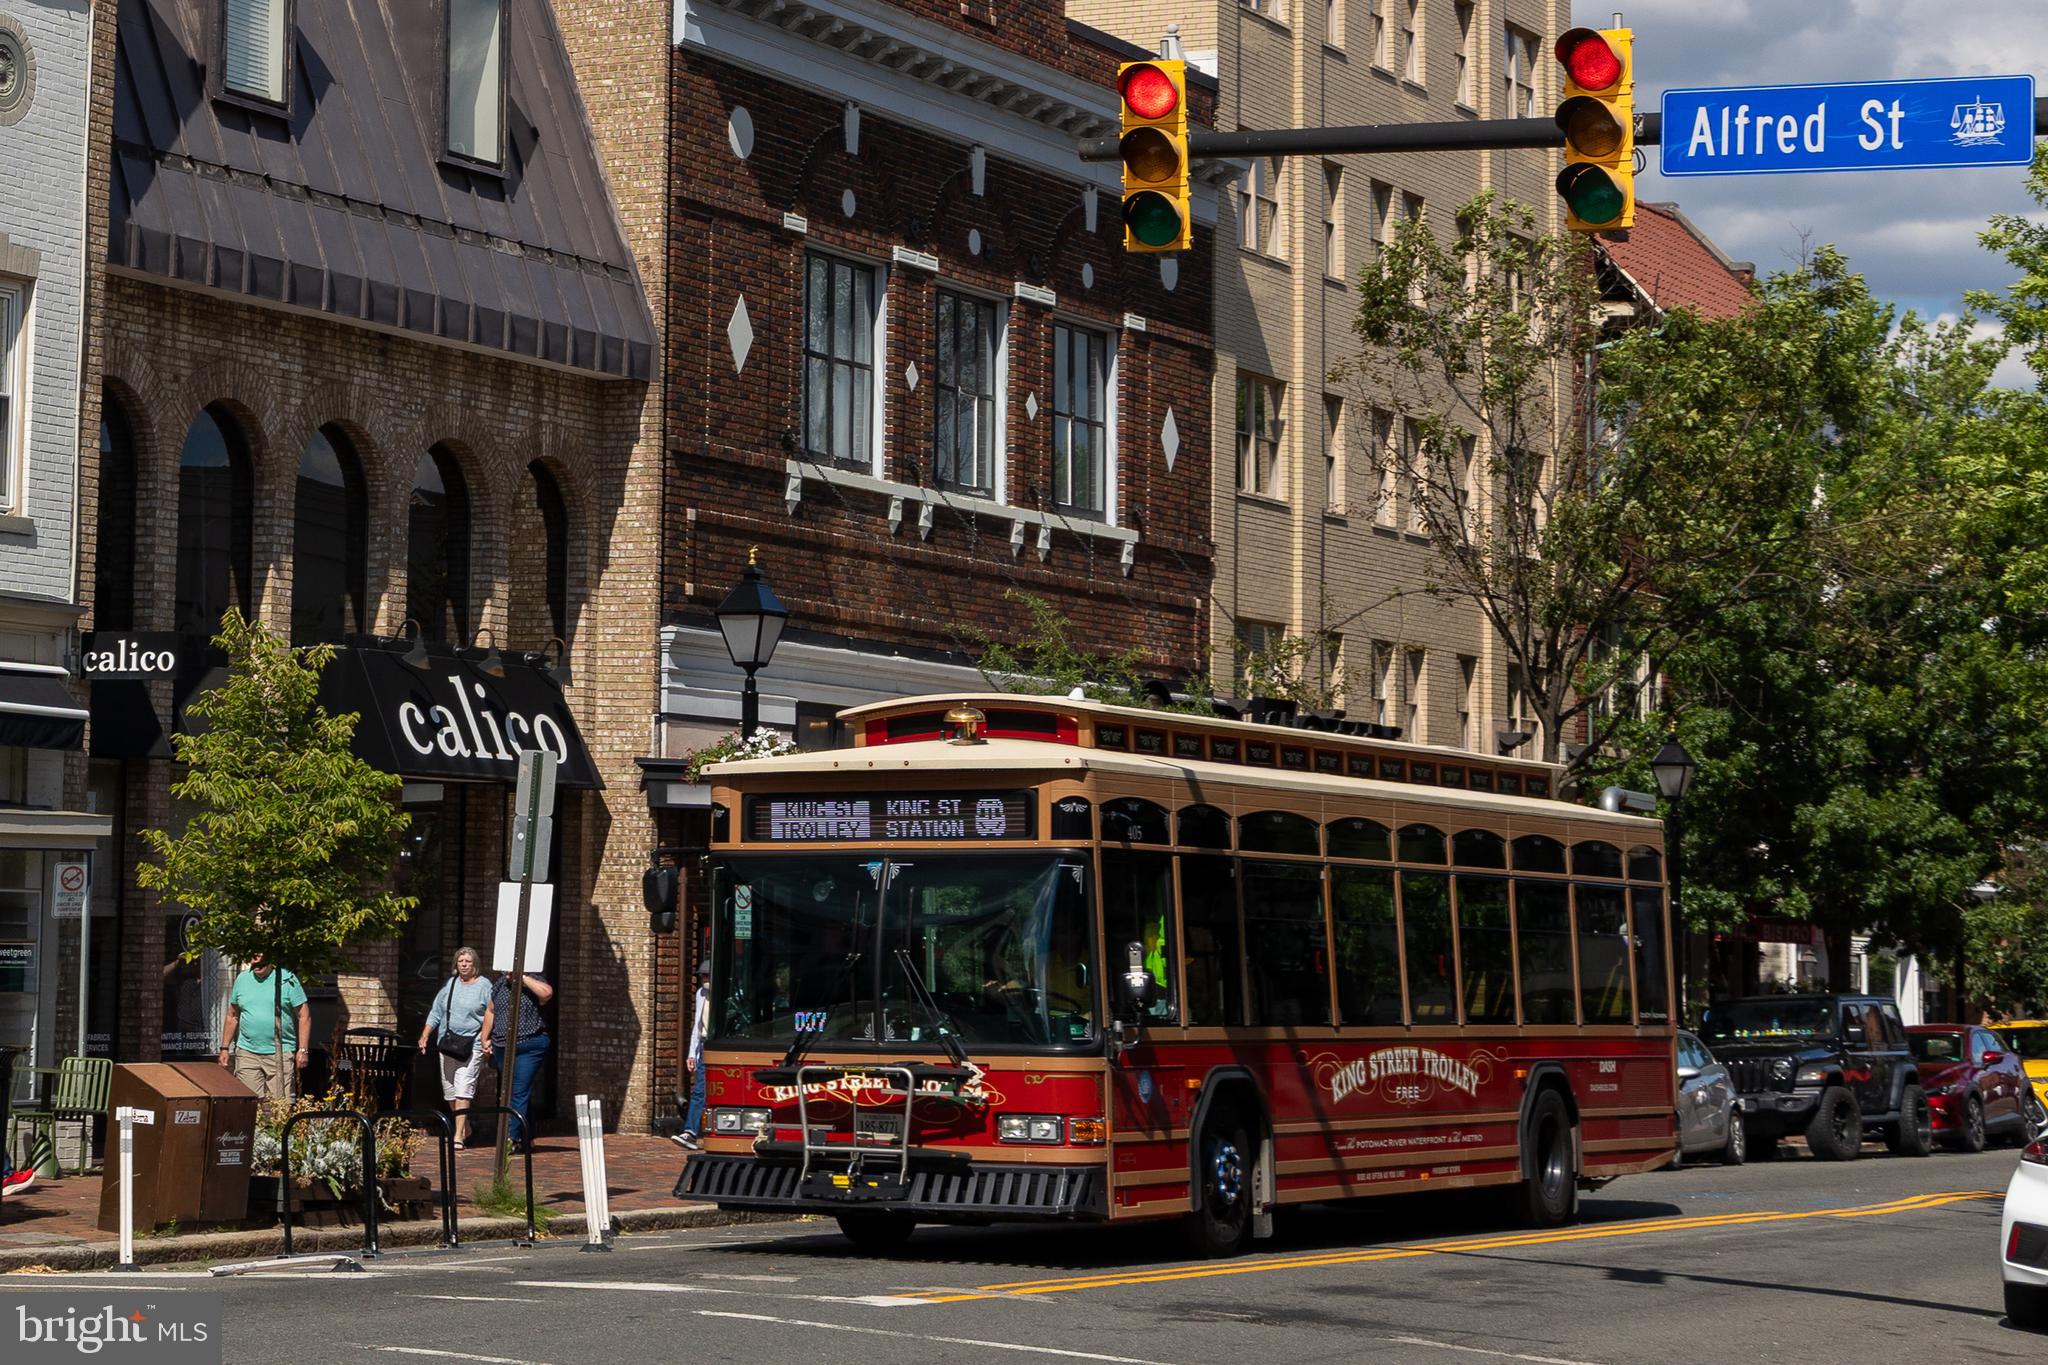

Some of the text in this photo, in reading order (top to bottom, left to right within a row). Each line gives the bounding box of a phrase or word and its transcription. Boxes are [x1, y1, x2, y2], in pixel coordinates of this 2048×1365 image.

[1688, 98, 1906, 157] Alfred St
[82, 639, 175, 672] calico
[399, 675, 568, 765] calico
[886, 799, 962, 816] KING ST
[781, 820, 860, 838] TROLLEY
[885, 819, 965, 837] STATION
[1763, 923, 1810, 942] BISTRO
[1330, 1048, 1480, 1105] KING STREET TROLLEY
[1396, 1086, 1420, 1098] FREE
[1356, 1139, 1388, 1149] POTOMAC
[1388, 1138, 1407, 1147] RIVER
[1407, 1136, 1447, 1146] WATERFRONT
[1462, 1134, 1483, 1143] METRO
